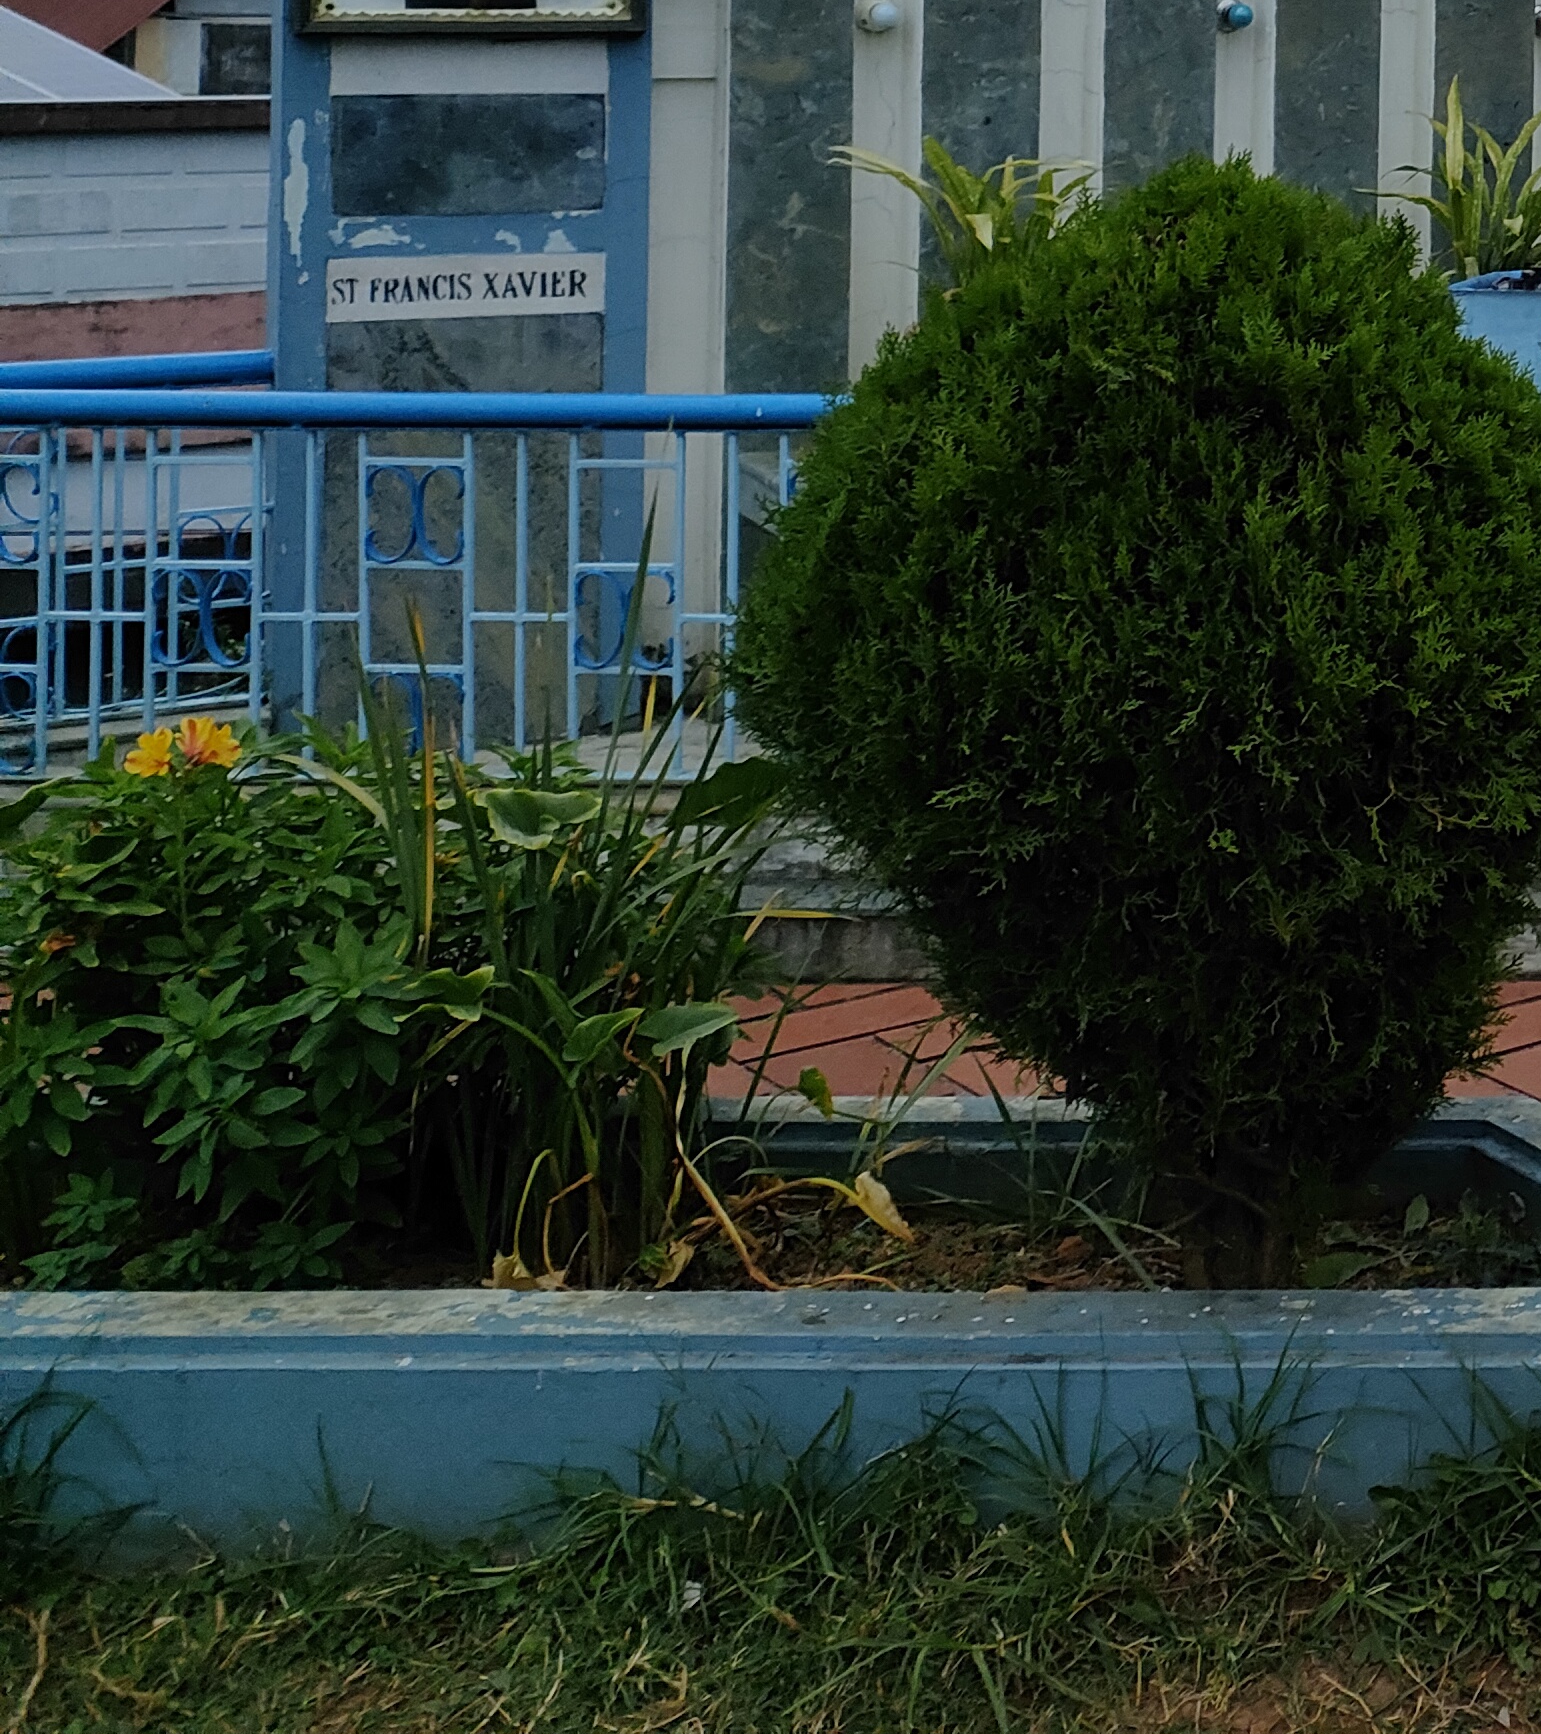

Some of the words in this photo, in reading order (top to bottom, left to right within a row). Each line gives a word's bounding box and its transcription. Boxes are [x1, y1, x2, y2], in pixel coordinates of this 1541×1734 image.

[331, 278, 359, 305] ST
[369, 272, 472, 304] FRANCIS
[482, 269, 588, 299] XAVIER
